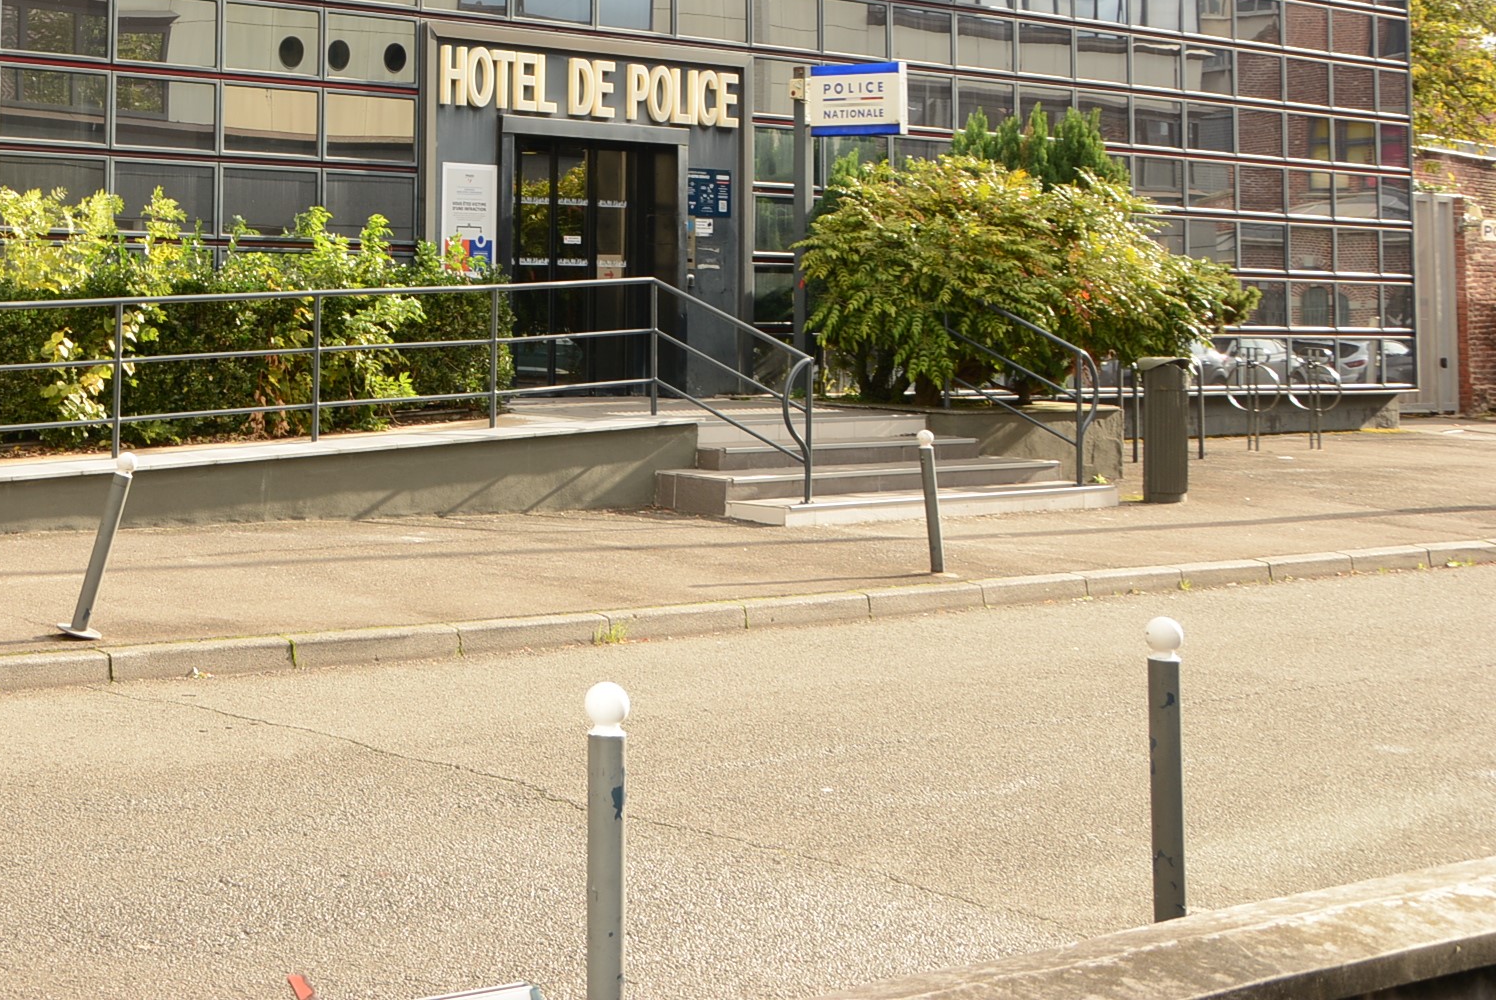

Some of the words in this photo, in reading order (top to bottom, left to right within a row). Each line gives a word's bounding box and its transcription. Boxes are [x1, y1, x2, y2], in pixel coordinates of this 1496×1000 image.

[439, 44, 557, 113] HOTEL
[568, 57, 616, 118] DE
[626, 63, 739, 128] POLICE
[823, 81, 884, 95] POLICE
[823, 108, 884, 119] NATIONALE
[1484, 225, 1496, 237] P
